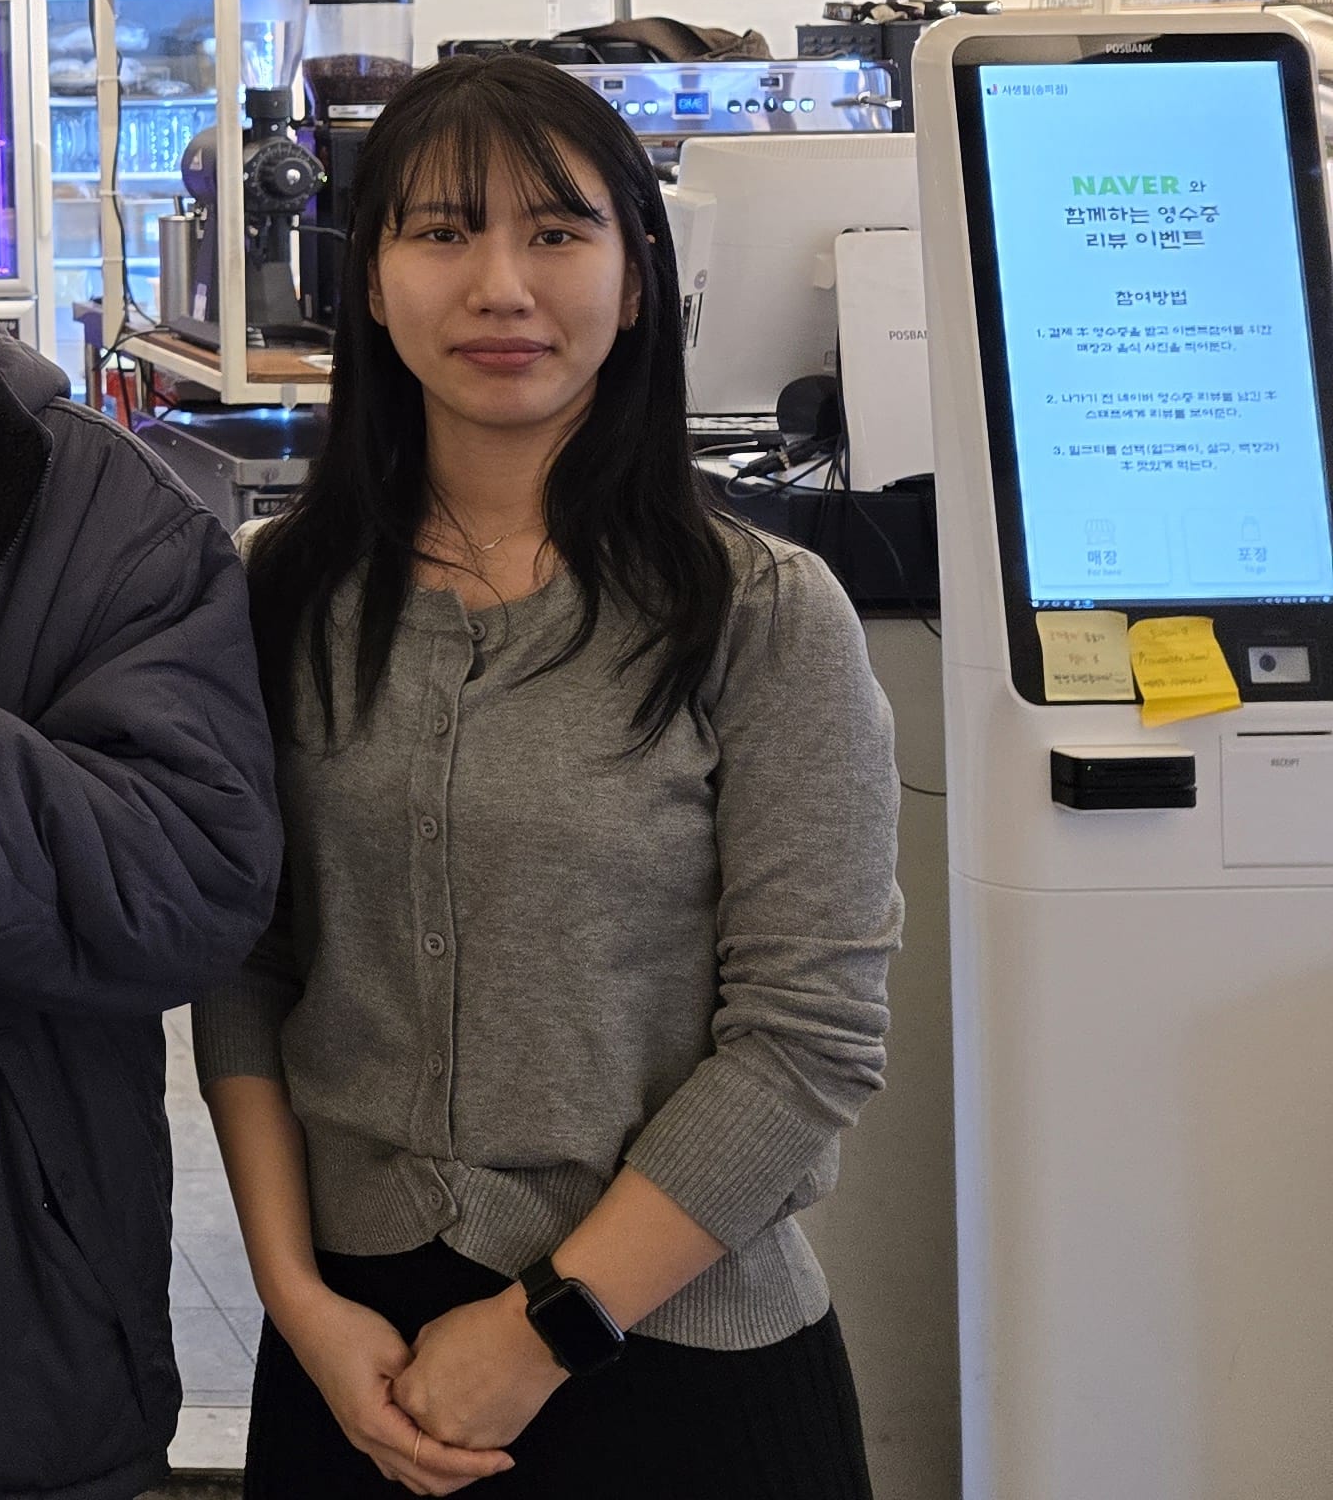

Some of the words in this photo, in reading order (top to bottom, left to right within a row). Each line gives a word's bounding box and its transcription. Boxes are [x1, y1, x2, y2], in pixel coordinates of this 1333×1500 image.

[1105, 43, 1153, 54] POSBANK
[1071, 175, 1181, 196] NAVER
[1188, 180, 1207, 193] 와
[1064, 206, 1150, 225] 함께하는
[1085, 232, 1129, 249] 리뷰
[1135, 230, 1206, 250] 이벤트
[1115, 289, 1188, 306] 참여방법
[1087, 550, 1117, 566] 매장
[1238, 547, 1267, 562] 포장
